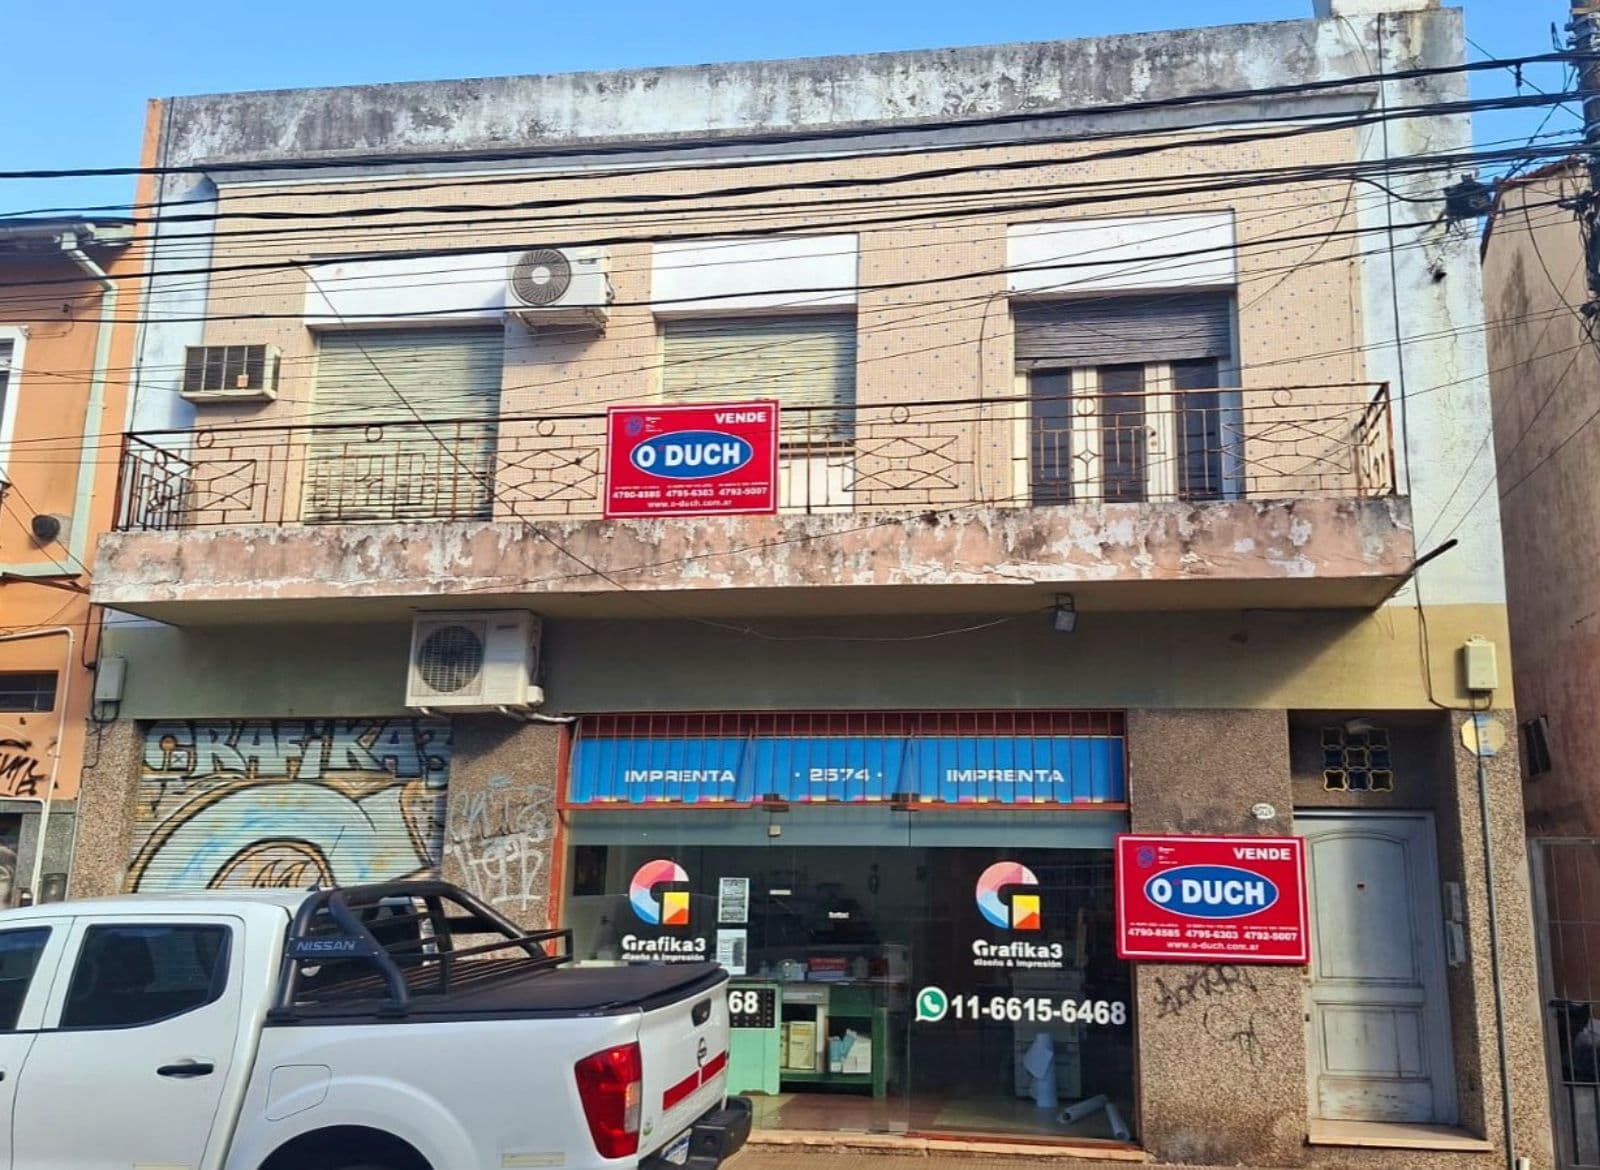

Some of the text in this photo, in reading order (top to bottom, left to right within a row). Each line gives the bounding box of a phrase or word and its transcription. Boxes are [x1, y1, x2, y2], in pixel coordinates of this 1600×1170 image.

[714, 411, 766, 424] VENDE
[624, 770, 736, 784] IMPRENTA
[809, 768, 870, 782] 2574
[946, 769, 1065, 783] IMPRENTA
[1233, 848, 1291, 860] VENDE
[296, 940, 356, 951] NISSAN
[621, 934, 706, 952] Grafika3
[972, 939, 1063, 958] Grafika3
[1166, 941, 1259, 951] www.o-duch.com.ar
[1006, 959, 1014, 967] &
[950, 995, 1127, 1025] 11-6615-6468
